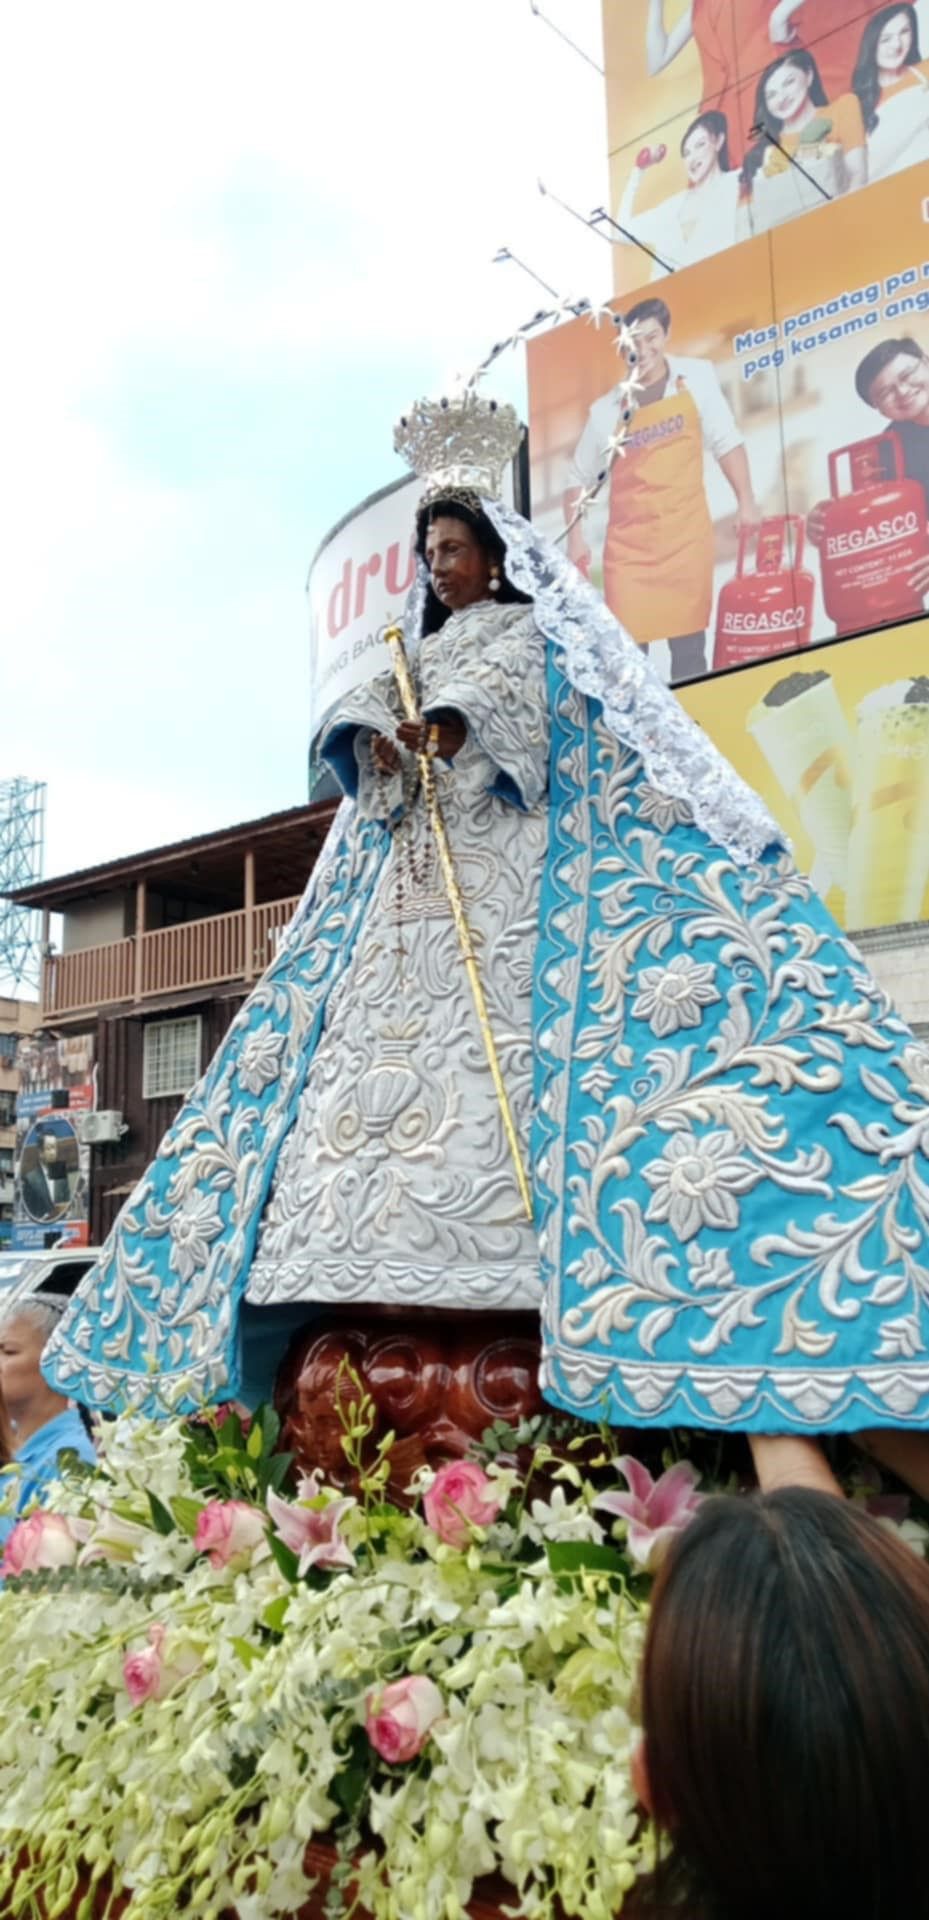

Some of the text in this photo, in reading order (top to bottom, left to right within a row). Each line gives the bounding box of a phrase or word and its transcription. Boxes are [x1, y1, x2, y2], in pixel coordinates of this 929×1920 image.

[736, 326, 777, 352] Mas
[784, 284, 880, 336] panatag
[886, 269, 916, 295] pa
[744, 291, 929, 379] pag kasama ang
[827, 511, 917, 554] REGASCO
[327, 533, 416, 639] dru
[724, 606, 805, 630] REGASCO
